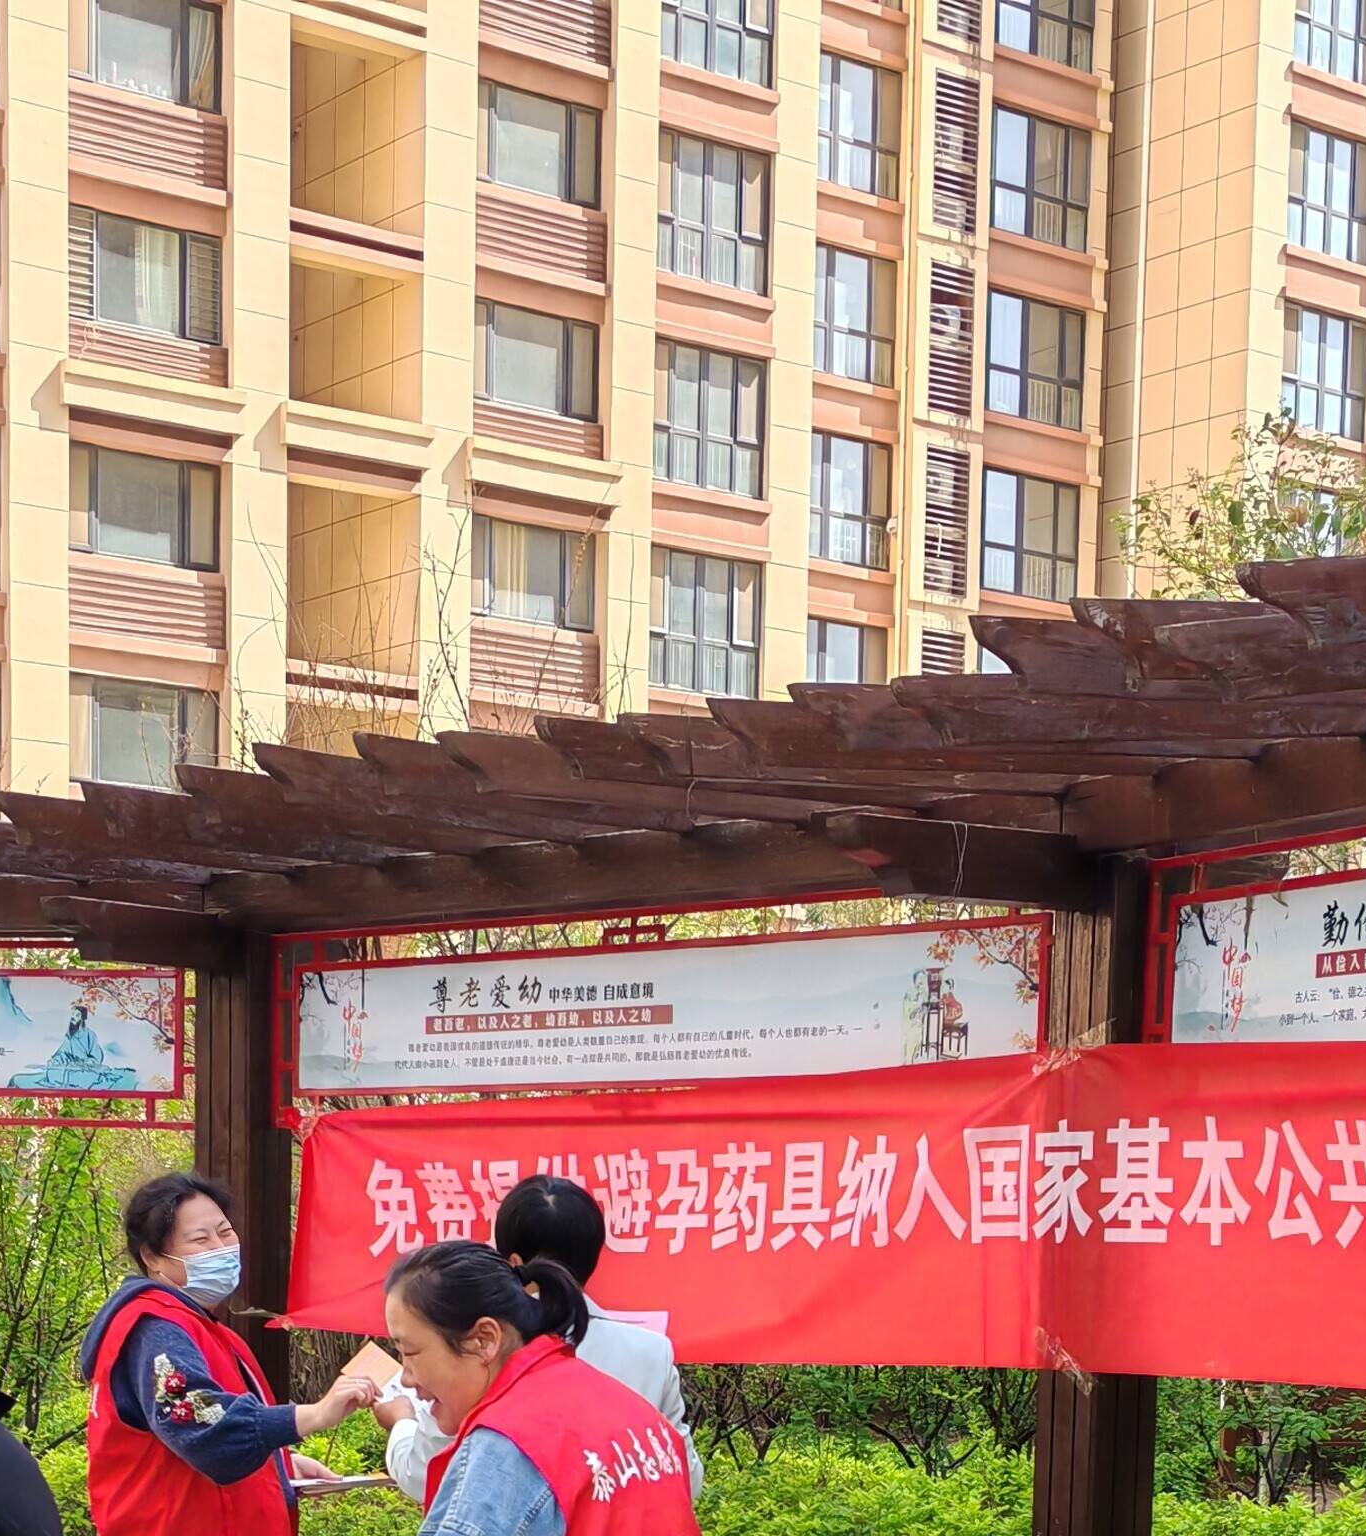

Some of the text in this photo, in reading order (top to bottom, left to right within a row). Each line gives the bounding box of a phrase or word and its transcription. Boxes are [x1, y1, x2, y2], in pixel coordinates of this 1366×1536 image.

[429, 974, 655, 1014] 尊老爱幼 中华美德 自成意境
[1222, 935, 1244, 1033] 中国梦
[342, 997, 364, 1073] 中国梦
